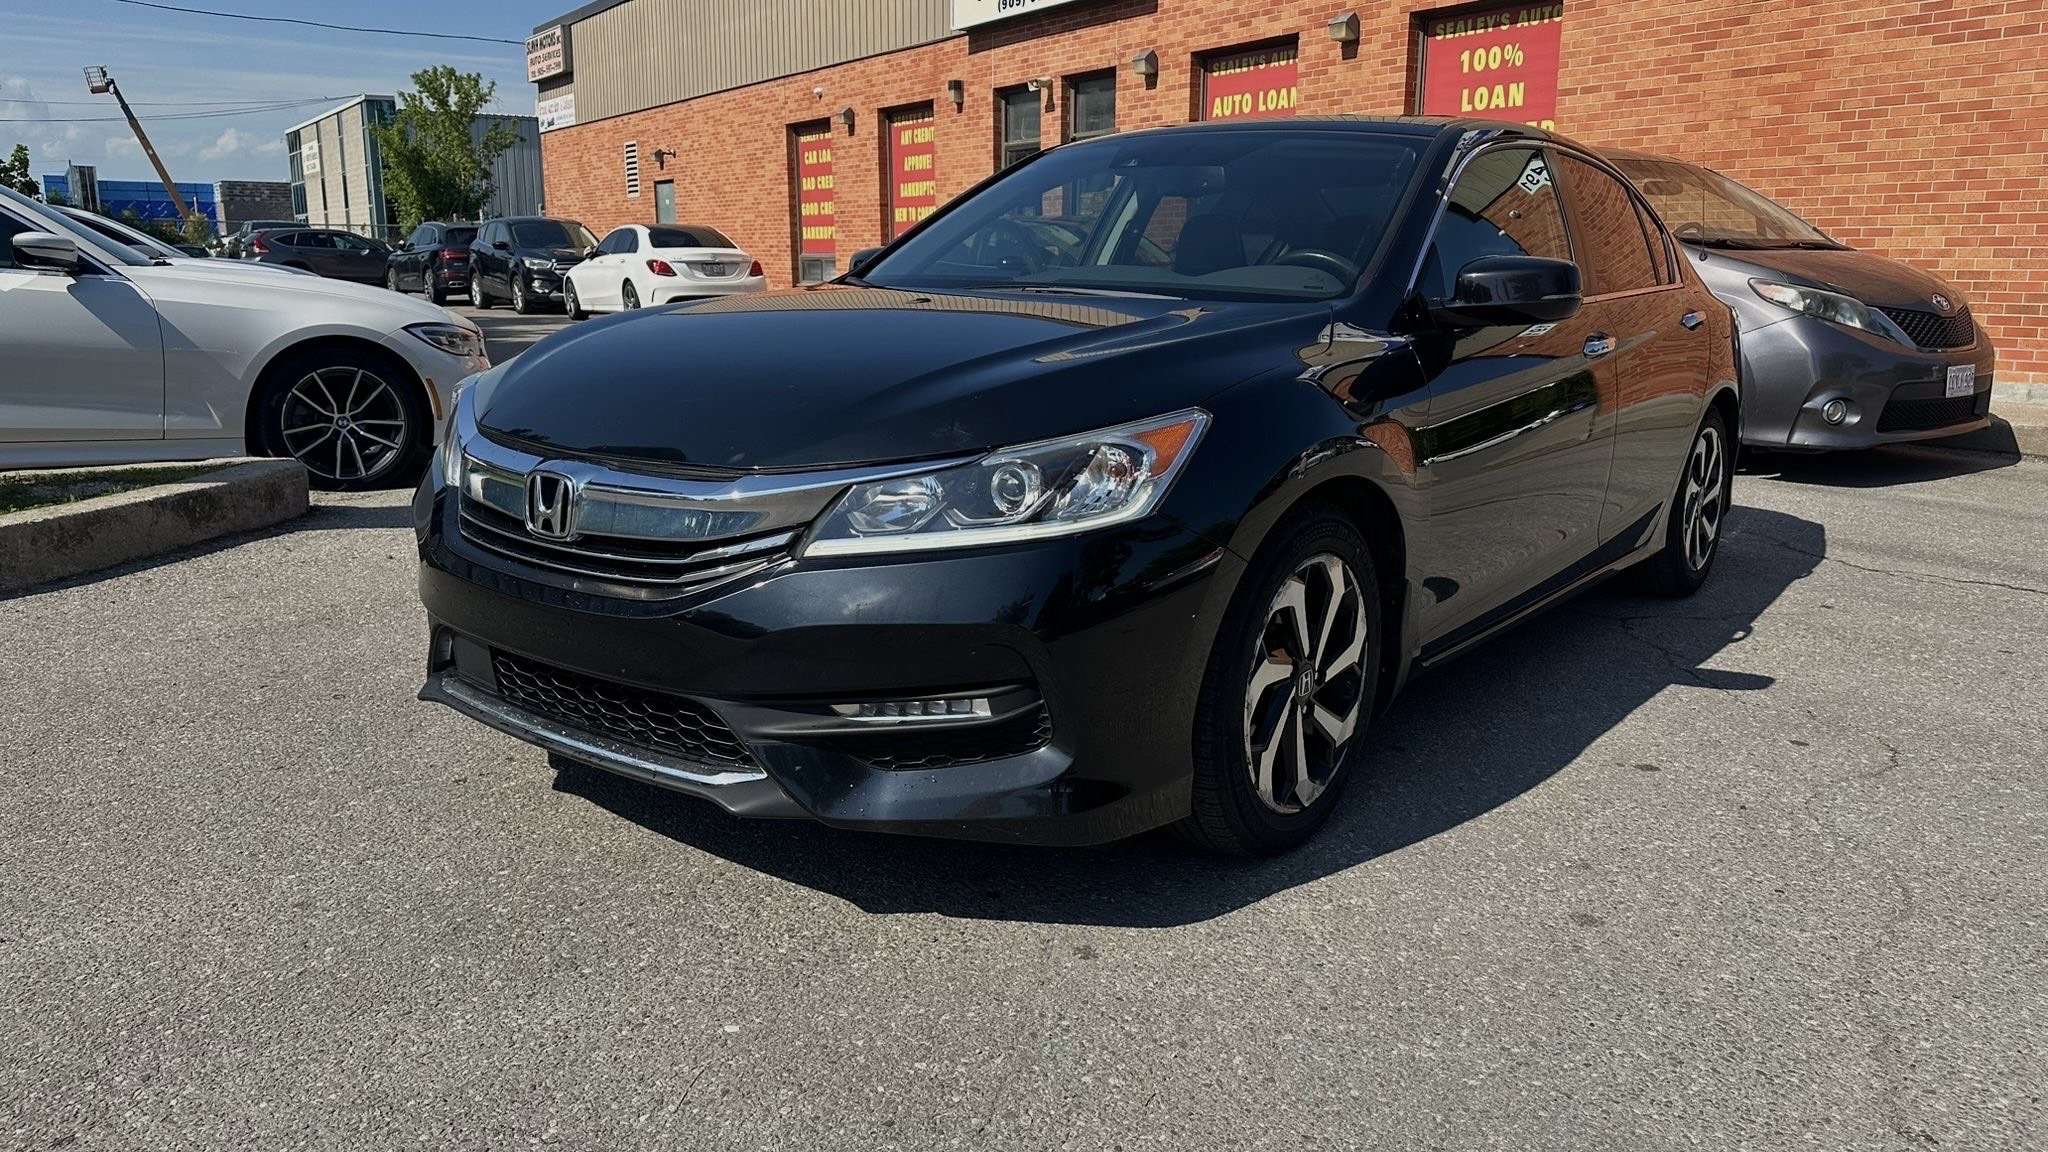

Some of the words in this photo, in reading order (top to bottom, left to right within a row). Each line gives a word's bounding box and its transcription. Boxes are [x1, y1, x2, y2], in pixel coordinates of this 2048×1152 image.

[1435, 12, 1510, 40] SEALEY'S
[1516, 4, 1562, 28] AUTO
[1212, 54, 1266, 76] SEALEY'S
[1270, 48, 1298, 67] AUT
[1460, 43, 1524, 74] 100%
[1212, 92, 1252, 118] AUTO
[1460, 82, 1525, 112] LOAN
[900, 130, 912, 146] ANY
[914, 126, 935, 144] CREDIT
[804, 150, 817, 165] CAR
[803, 177, 816, 191] BAD
[802, 202, 818, 216] GOOD
[895, 207, 908, 222] NEW
[909, 206, 916, 222] TO
